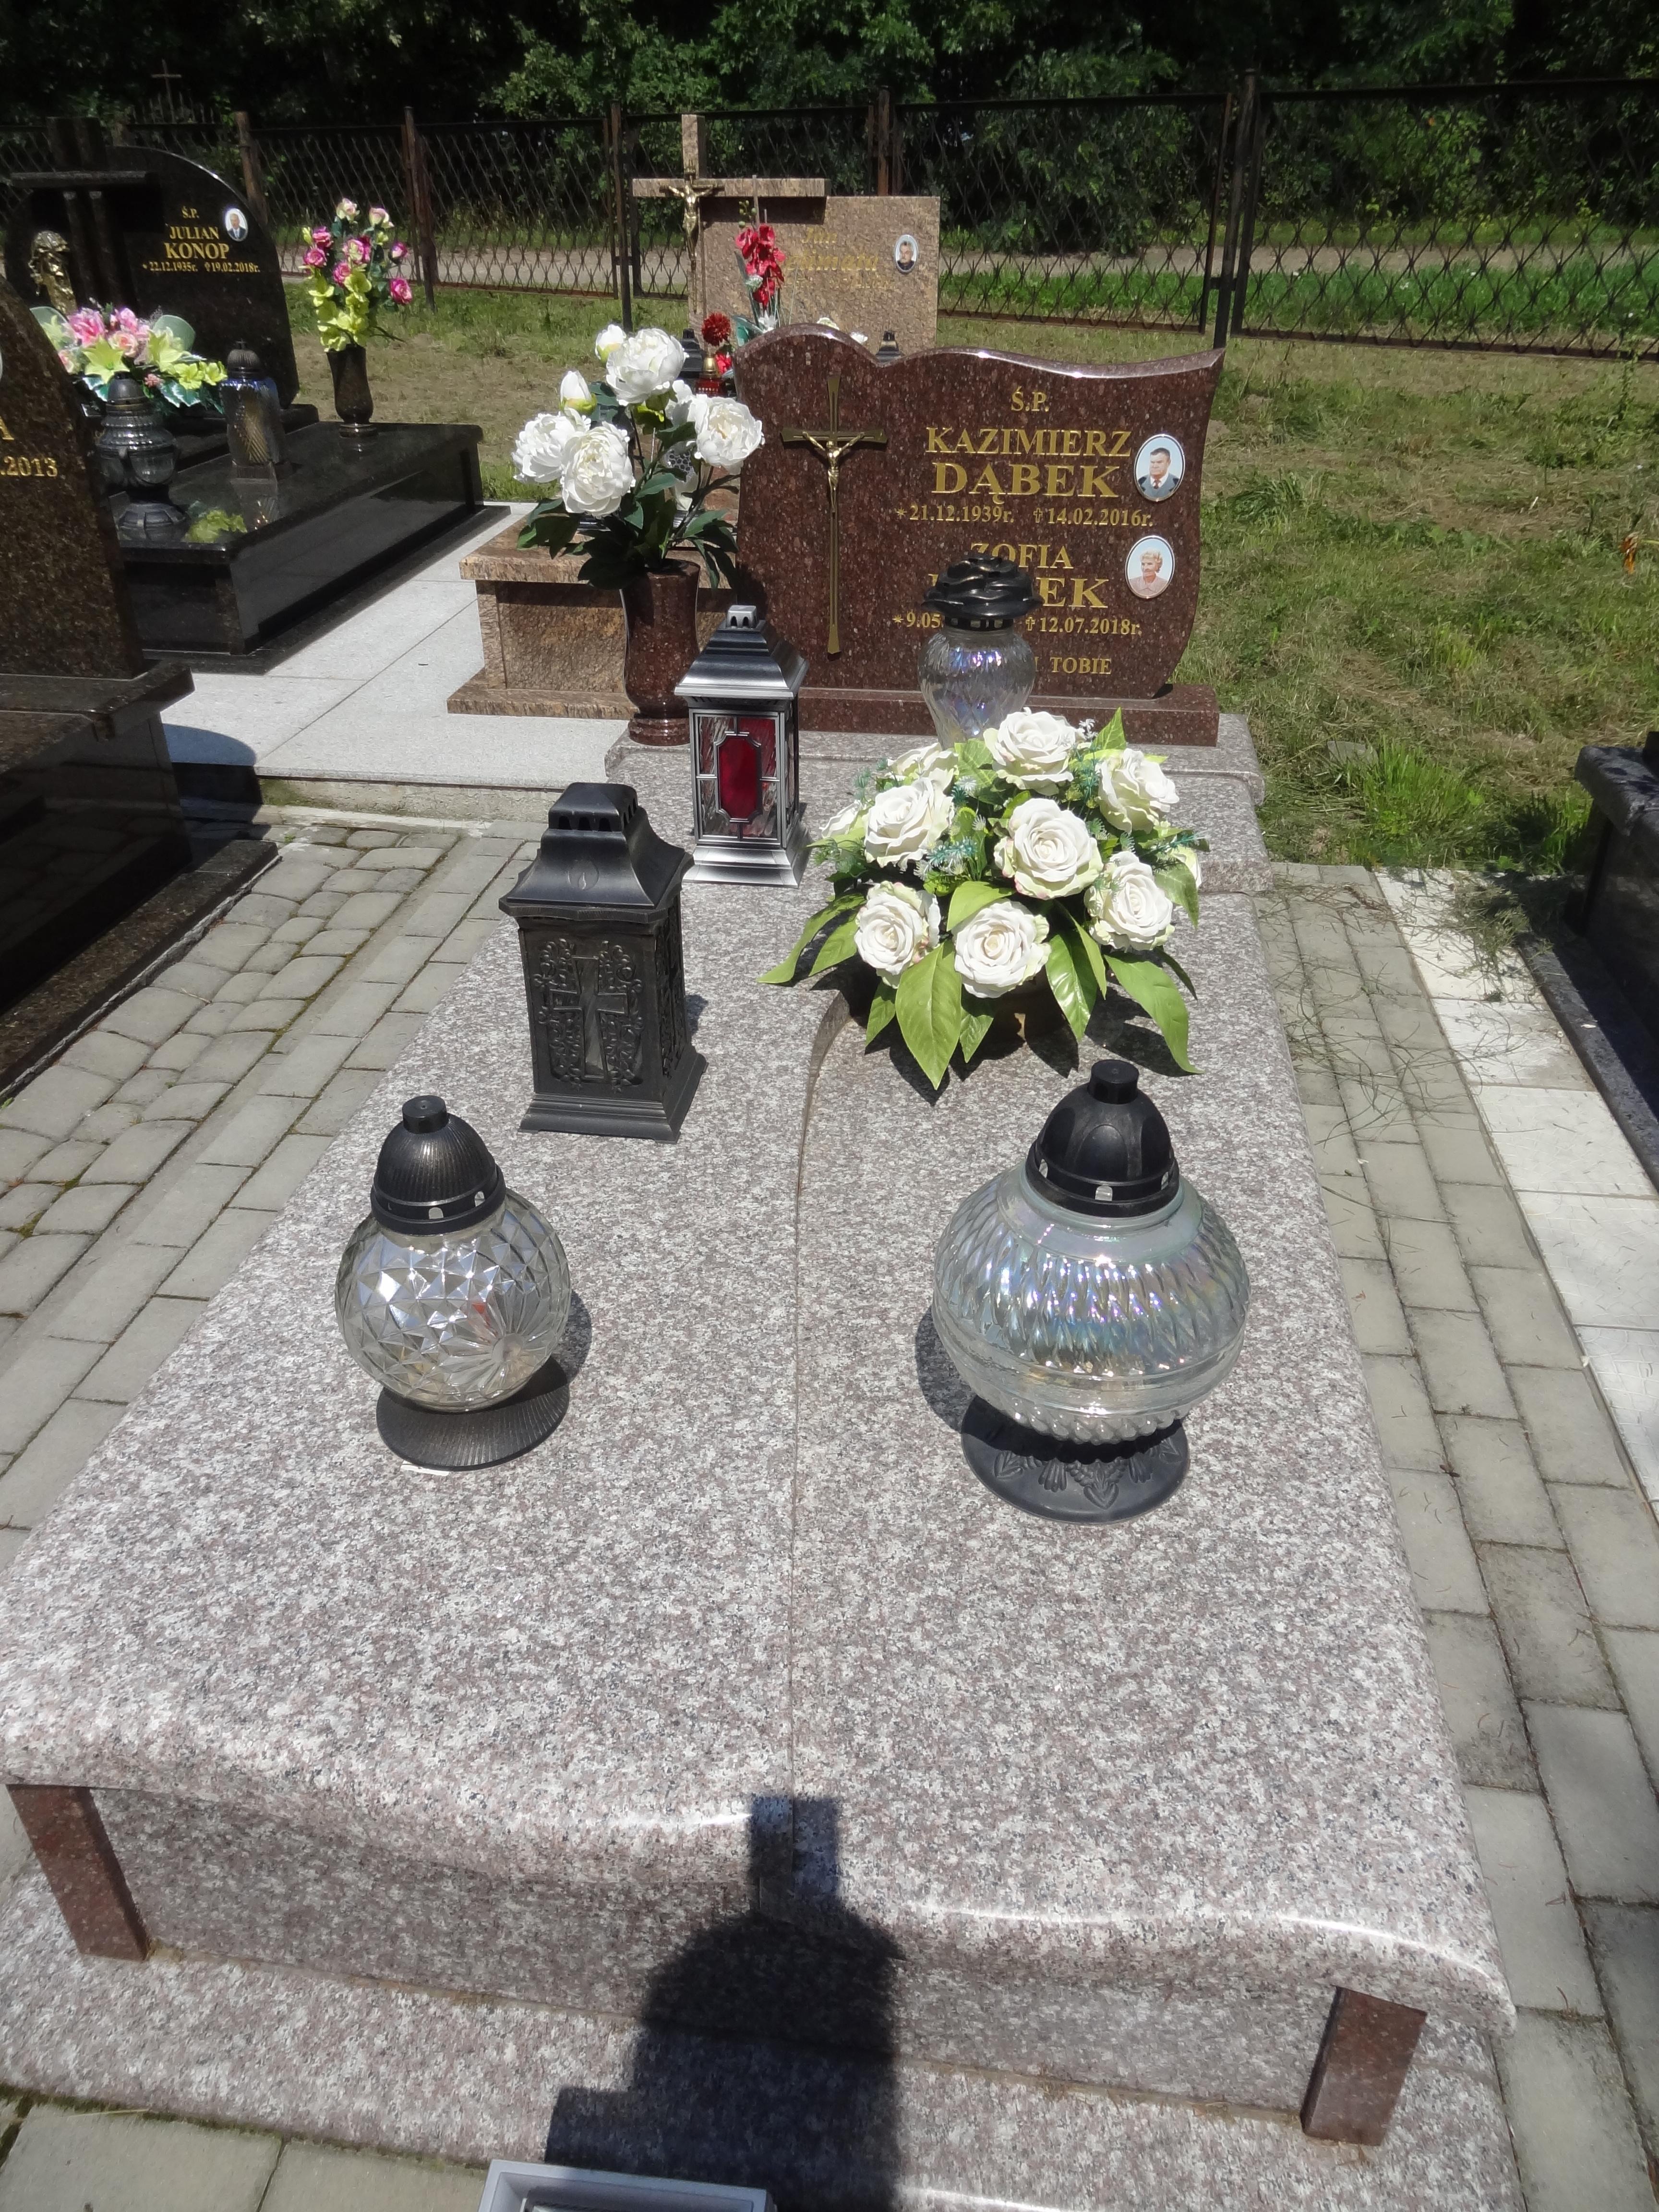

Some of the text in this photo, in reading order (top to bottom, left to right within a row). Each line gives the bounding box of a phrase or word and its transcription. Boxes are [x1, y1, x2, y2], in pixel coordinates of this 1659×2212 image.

[169, 226, 219, 240] JULIAN
[164, 242, 230, 260] KONOP
[1011, 387, 1049, 412] Ś.P.
[926, 427, 1132, 457] KAZIMIERZ
[931, 462, 1119, 504] DĄBEK
[910, 505, 1154, 527] 21.12.1939r. 14.02.2016r.
[1040, 617, 1142, 635] 12.07.2018r.
[1049, 656, 1112, 674] TOBIE
